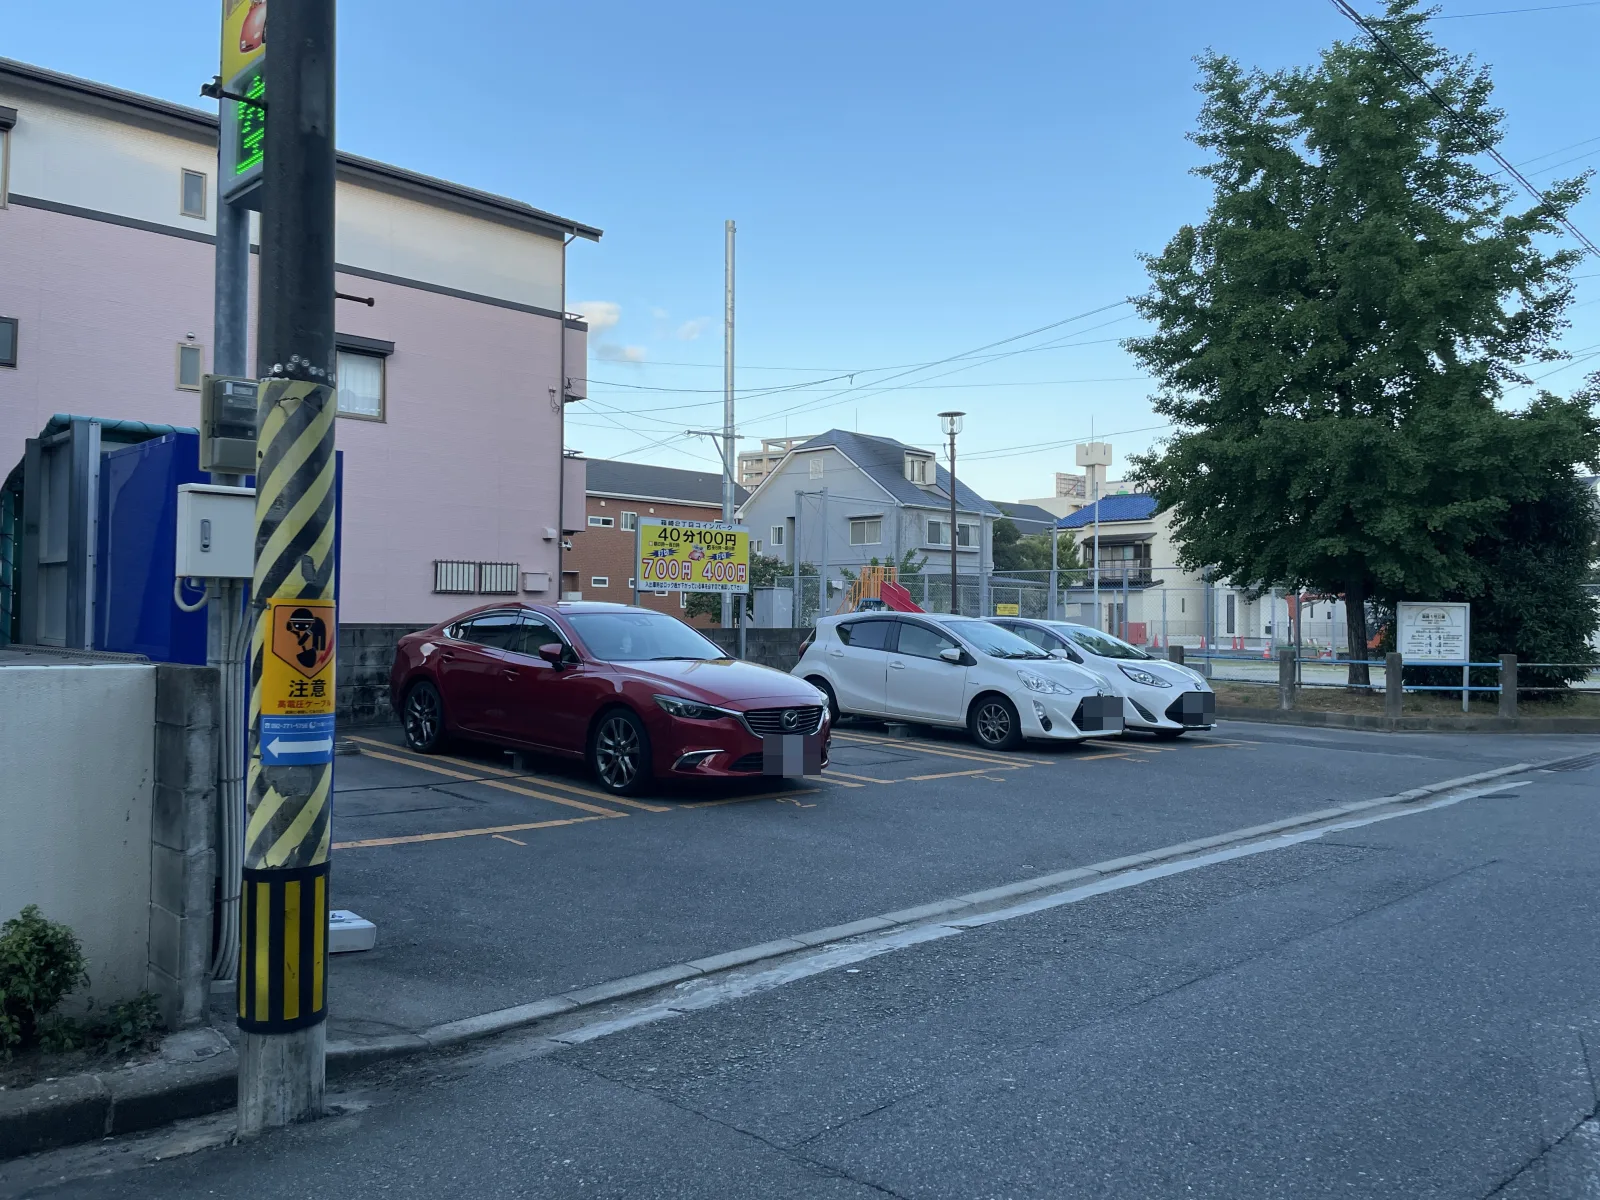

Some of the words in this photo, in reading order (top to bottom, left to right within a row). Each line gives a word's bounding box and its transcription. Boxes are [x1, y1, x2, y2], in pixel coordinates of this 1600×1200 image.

[642, 558, 692, 580] 700円
[702, 561, 747, 582] 400円
[288, 679, 326, 697] 注意
[277, 700, 331, 708] 高電圧ケーブル
[776, 797, 818, 808] 2
